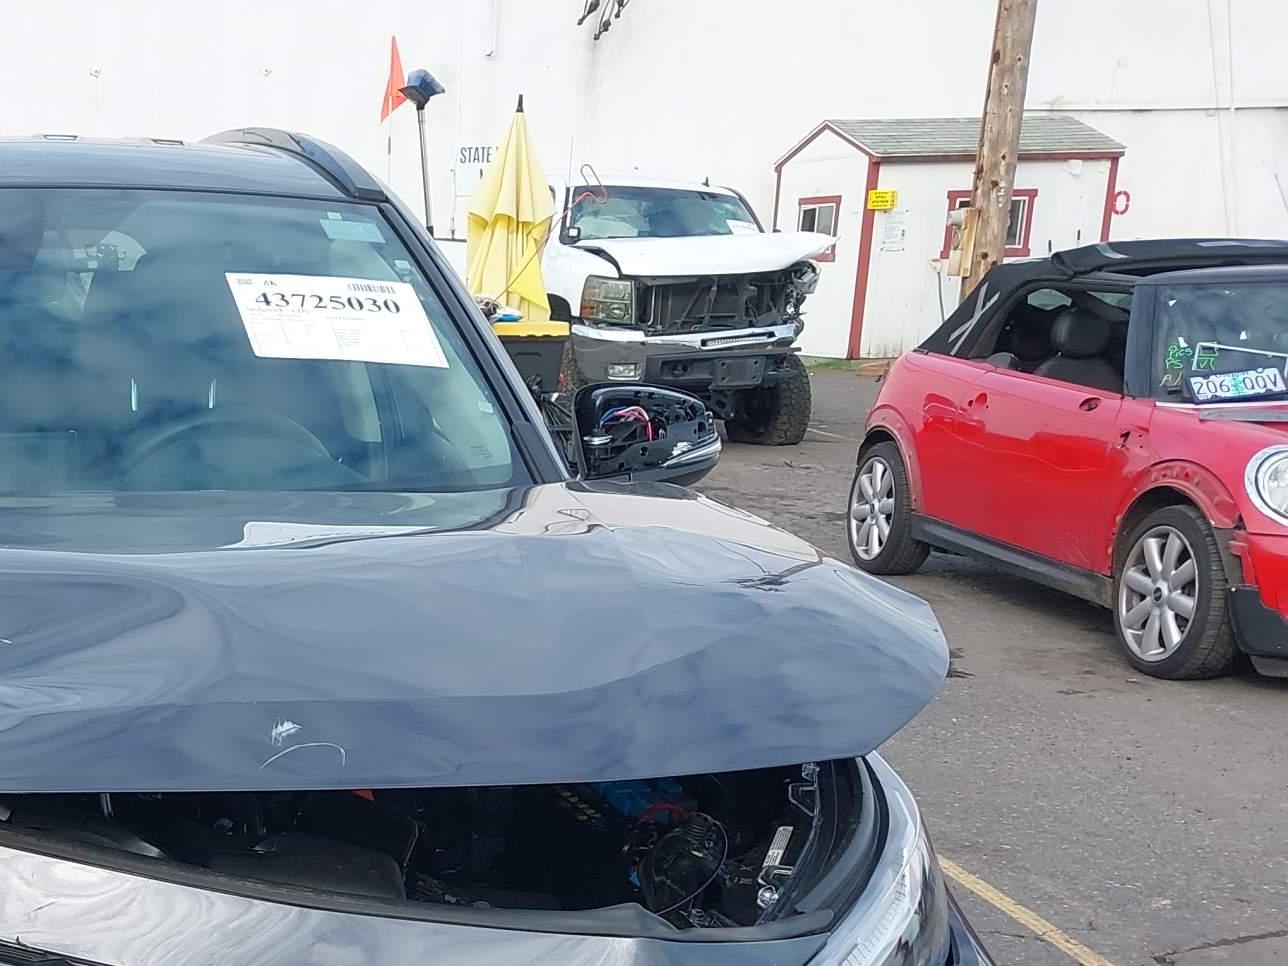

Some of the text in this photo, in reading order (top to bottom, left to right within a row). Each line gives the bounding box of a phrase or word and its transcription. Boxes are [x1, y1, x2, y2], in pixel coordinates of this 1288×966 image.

[460, 146, 492, 164] STATE
[255, 292, 401, 314] 43725030
[1193, 379, 1230, 395] 206
